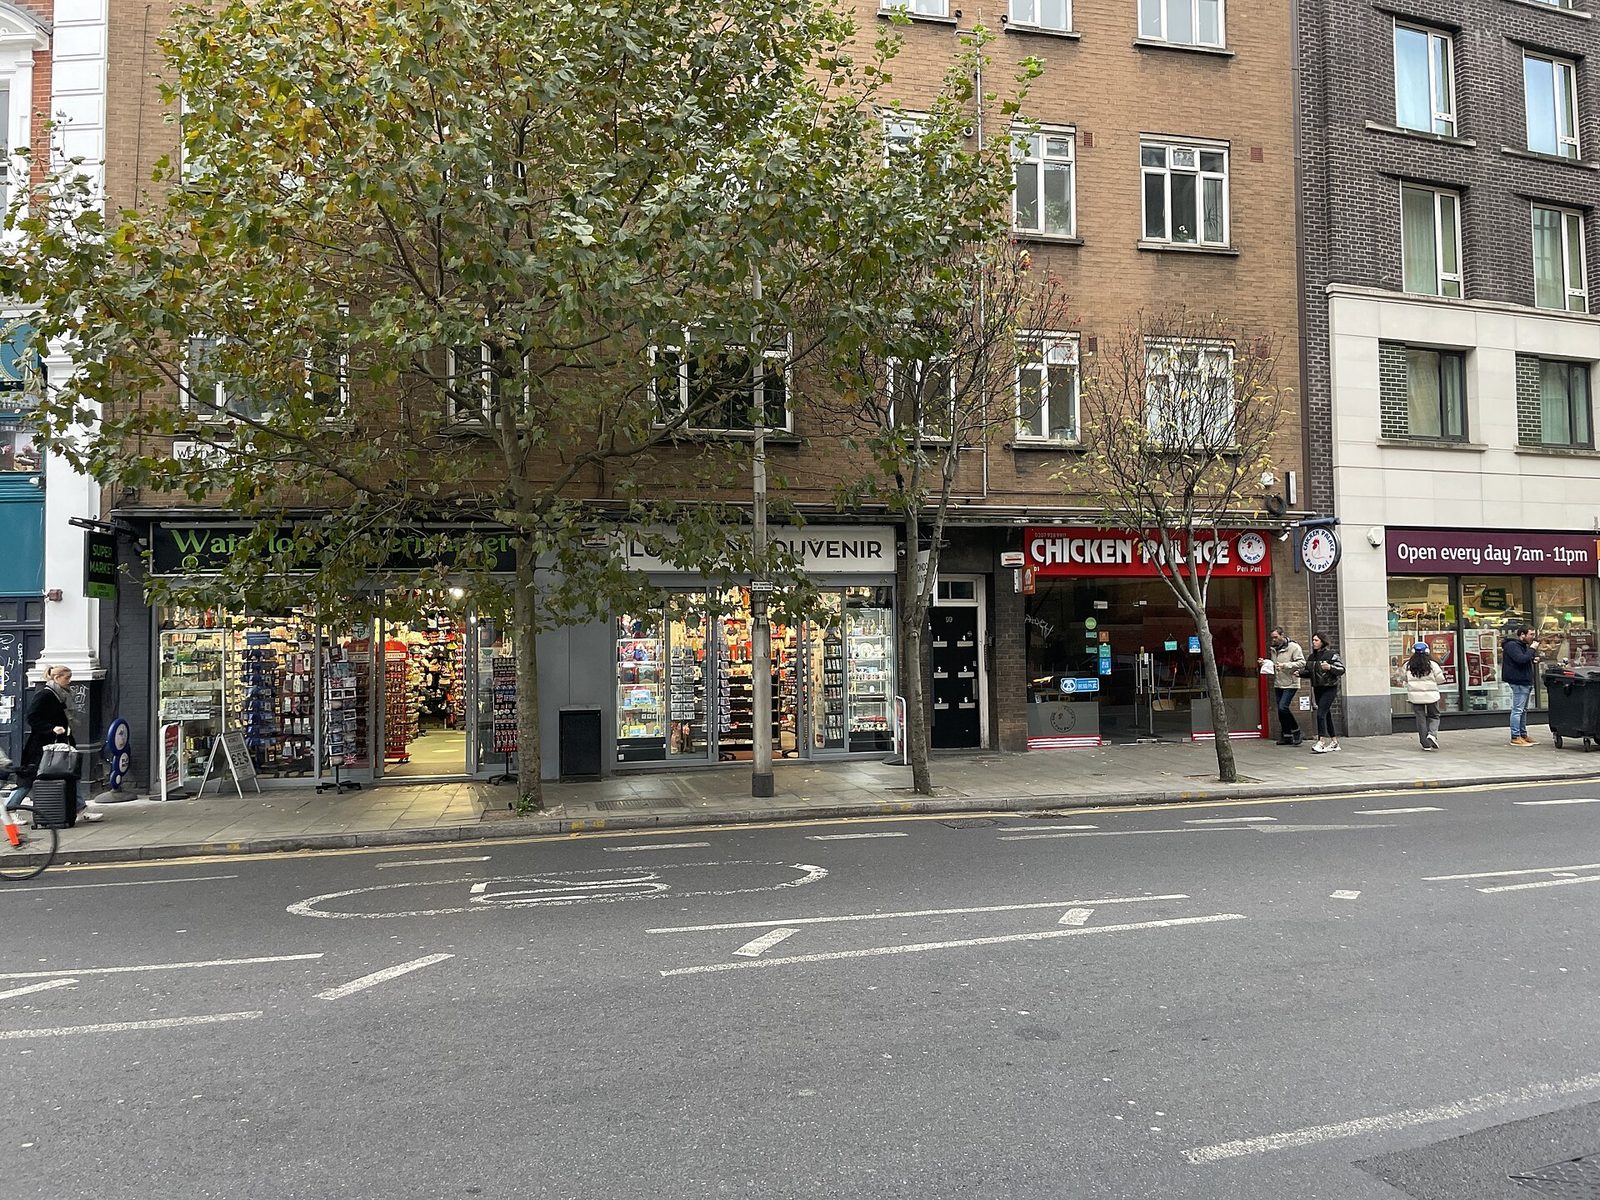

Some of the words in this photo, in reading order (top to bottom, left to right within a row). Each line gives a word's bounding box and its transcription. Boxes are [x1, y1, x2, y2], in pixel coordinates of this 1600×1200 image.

[766, 540, 882, 559] OUVENIR
[1303, 530, 1320, 551] CHICKEN
[1321, 530, 1335, 551] PALACE
[1031, 538, 1132, 566] CHICKEN
[1397, 543, 1437, 563] Open
[1440, 546, 1481, 565] every
[1484, 544, 1511, 566] day
[1514, 546, 1544, 562] 7am
[1553, 546, 1588, 566] 11pm
[90, 560, 115, 574] MARKET
